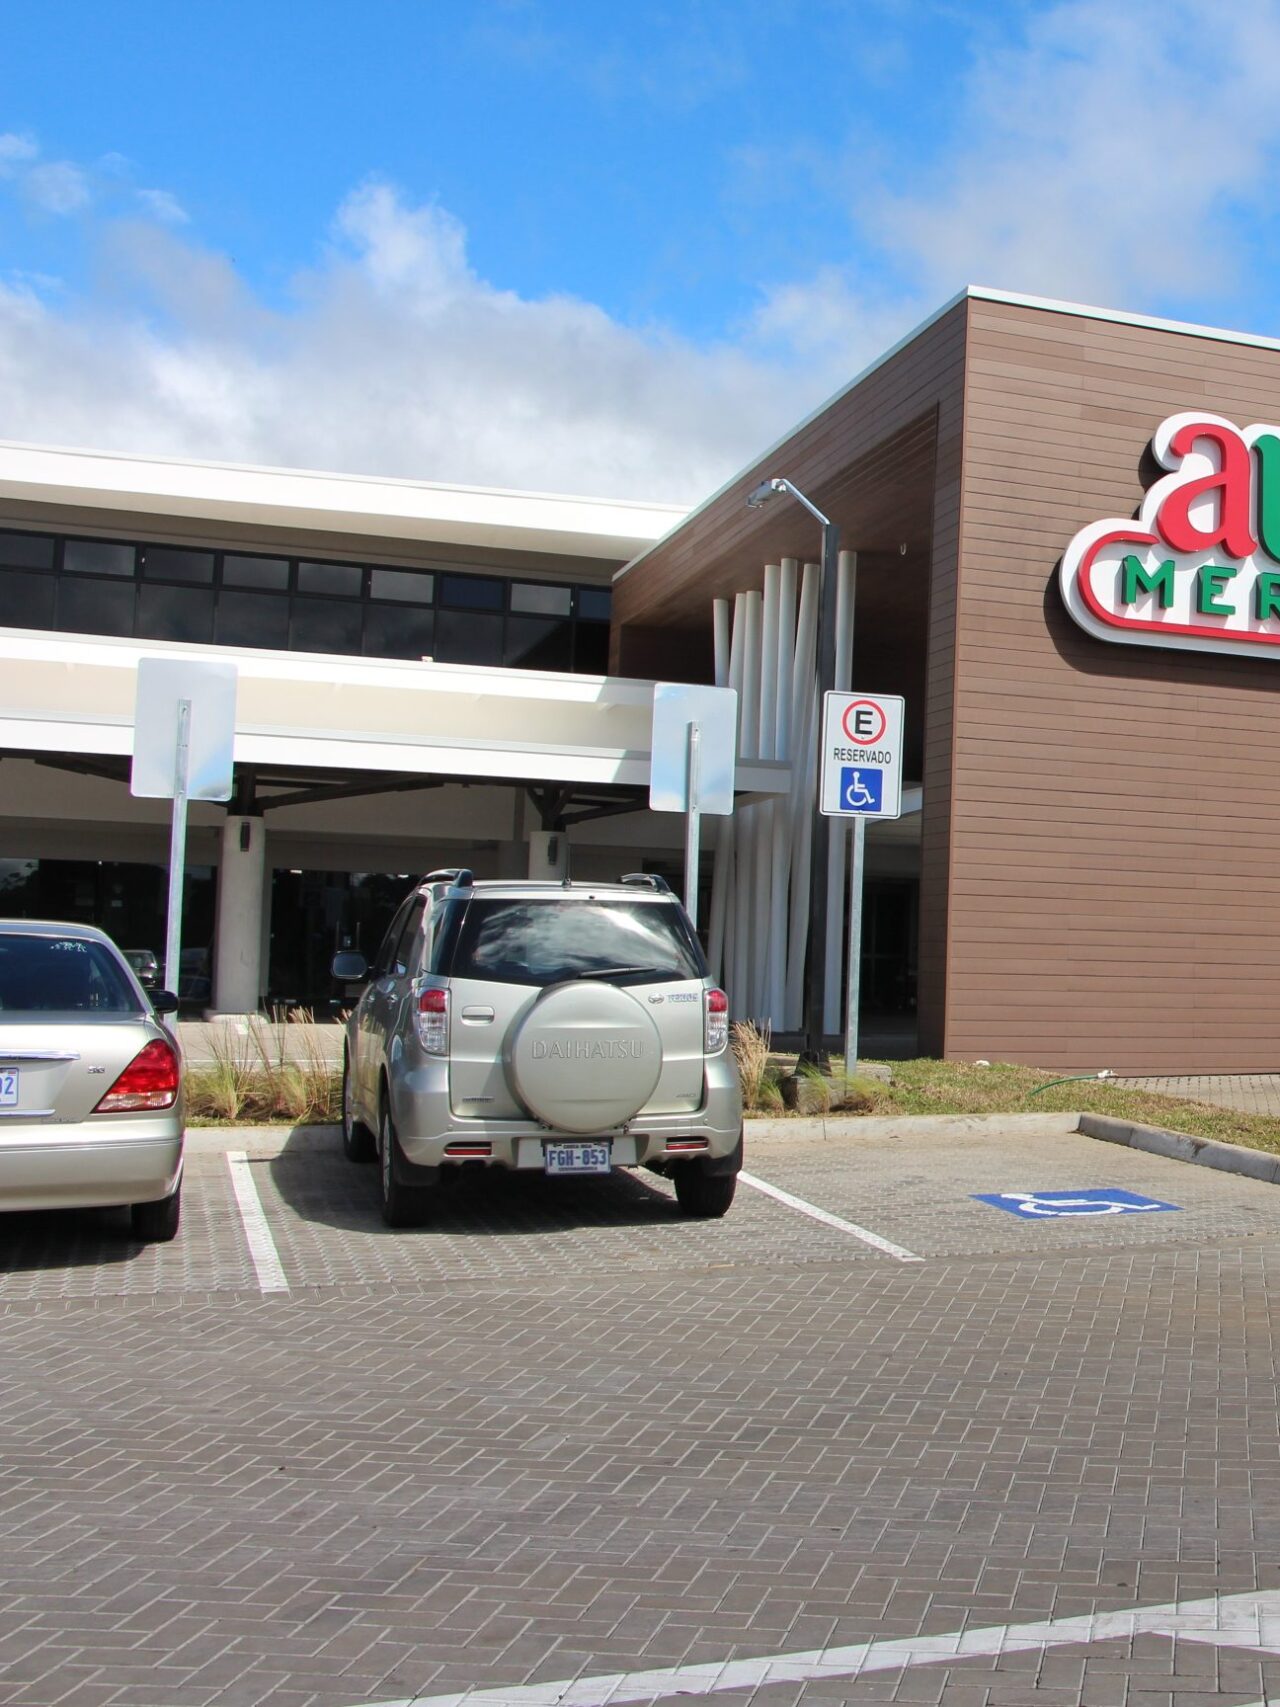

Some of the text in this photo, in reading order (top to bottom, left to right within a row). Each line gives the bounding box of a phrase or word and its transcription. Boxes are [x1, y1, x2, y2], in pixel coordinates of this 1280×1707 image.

[855, 710, 873, 735] E
[833, 747, 892, 765] RESERVADO
[531, 1039, 644, 1059] DAIHATSU
[548, 1149, 607, 1166] FGH-853
